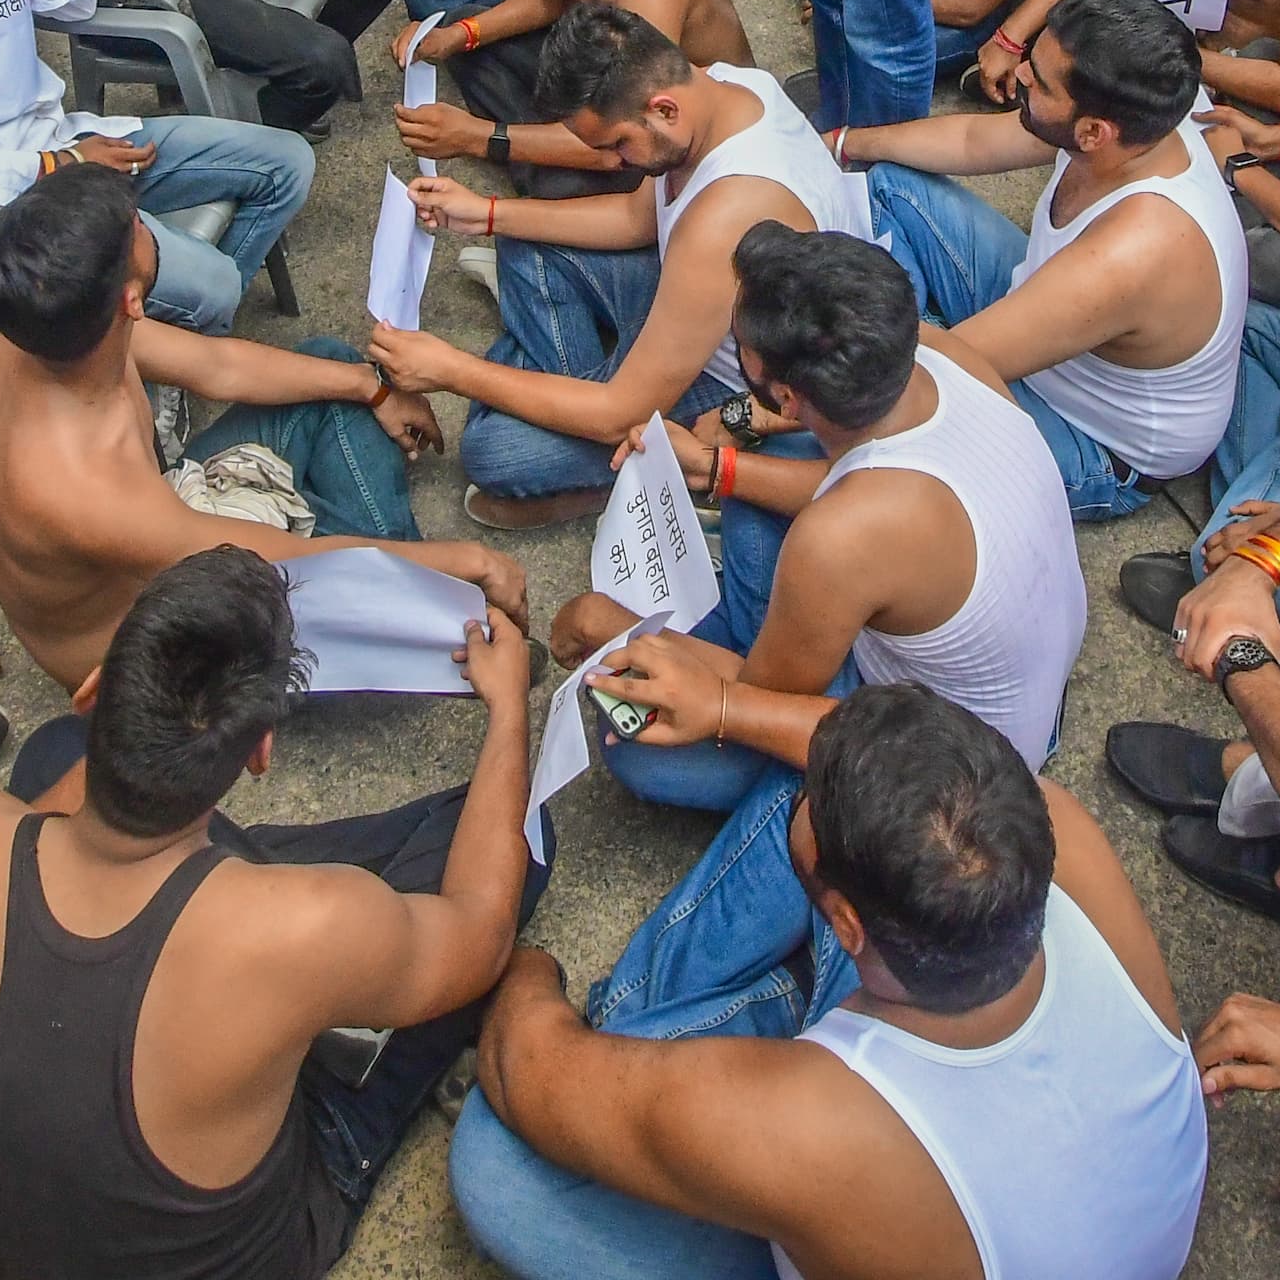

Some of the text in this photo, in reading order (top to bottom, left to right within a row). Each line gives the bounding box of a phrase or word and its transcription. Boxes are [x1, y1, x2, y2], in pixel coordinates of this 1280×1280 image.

[609, 538, 636, 586] करो
[627, 484, 670, 604] चुनाव बहाल
[660, 480, 688, 564] छात्रसंघ
